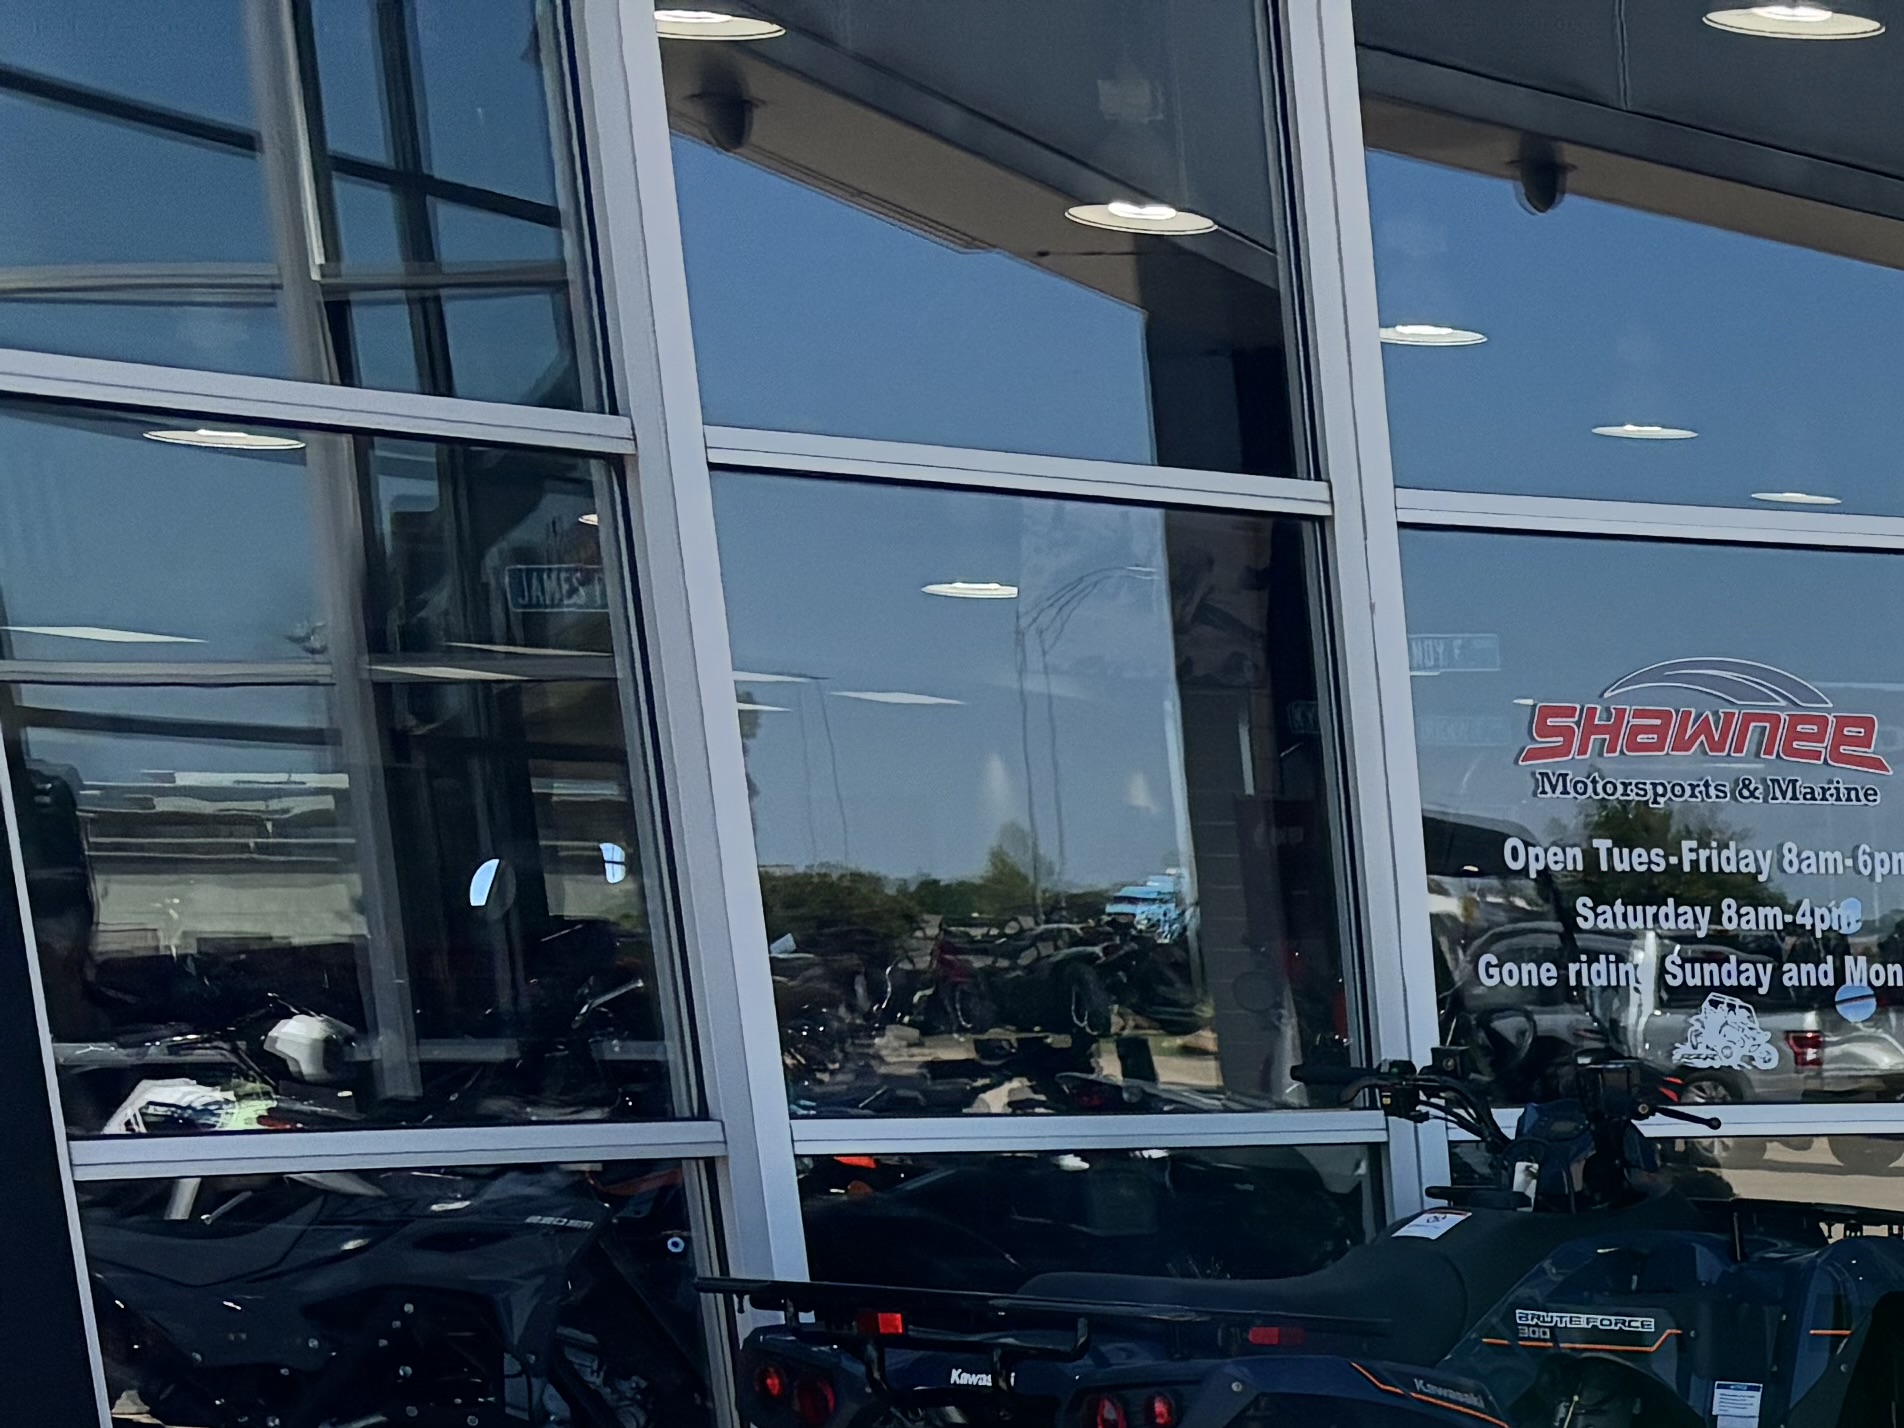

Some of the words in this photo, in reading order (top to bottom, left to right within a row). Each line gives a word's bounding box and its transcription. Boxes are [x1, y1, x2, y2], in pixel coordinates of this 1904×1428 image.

[1536, 771, 1729, 807] Motorsports
[1736, 776, 1762, 802] &
[1769, 778, 1881, 806] Marine
[1504, 838, 1583, 878] Open
[1592, 839, 1772, 881] Tues-Friday
[1576, 897, 1711, 937] Saturday
[1477, 953, 1558, 988] Gone
[1664, 954, 1773, 995] Sunday
[1782, 955, 1835, 987] and
[1518, 1325, 1551, 1339] 300
[950, 1368, 1016, 1387] Kawasi
